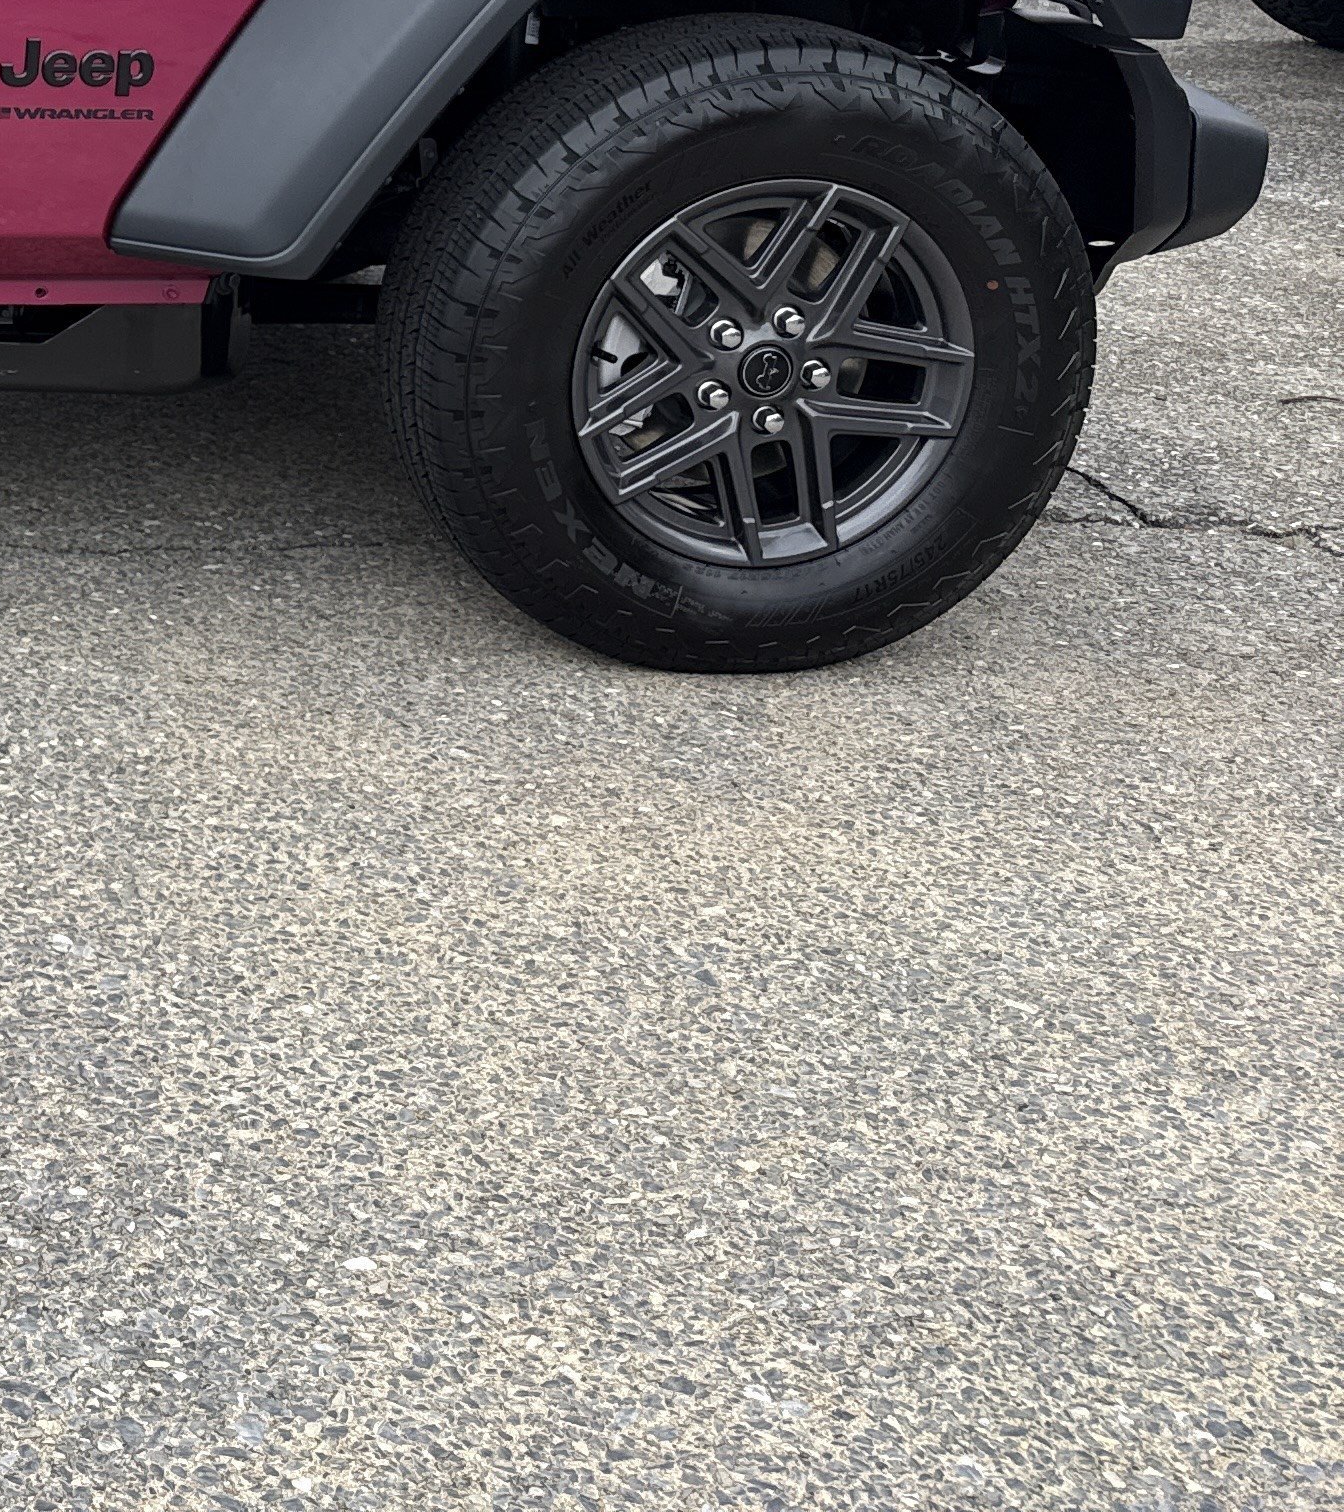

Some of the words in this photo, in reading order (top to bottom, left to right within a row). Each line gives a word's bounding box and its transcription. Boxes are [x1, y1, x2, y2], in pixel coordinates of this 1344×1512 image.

[0, 38, 155, 97] Jeep
[14, 107, 154, 121] WRANGLER
[522, 417, 656, 600] NEXEN
